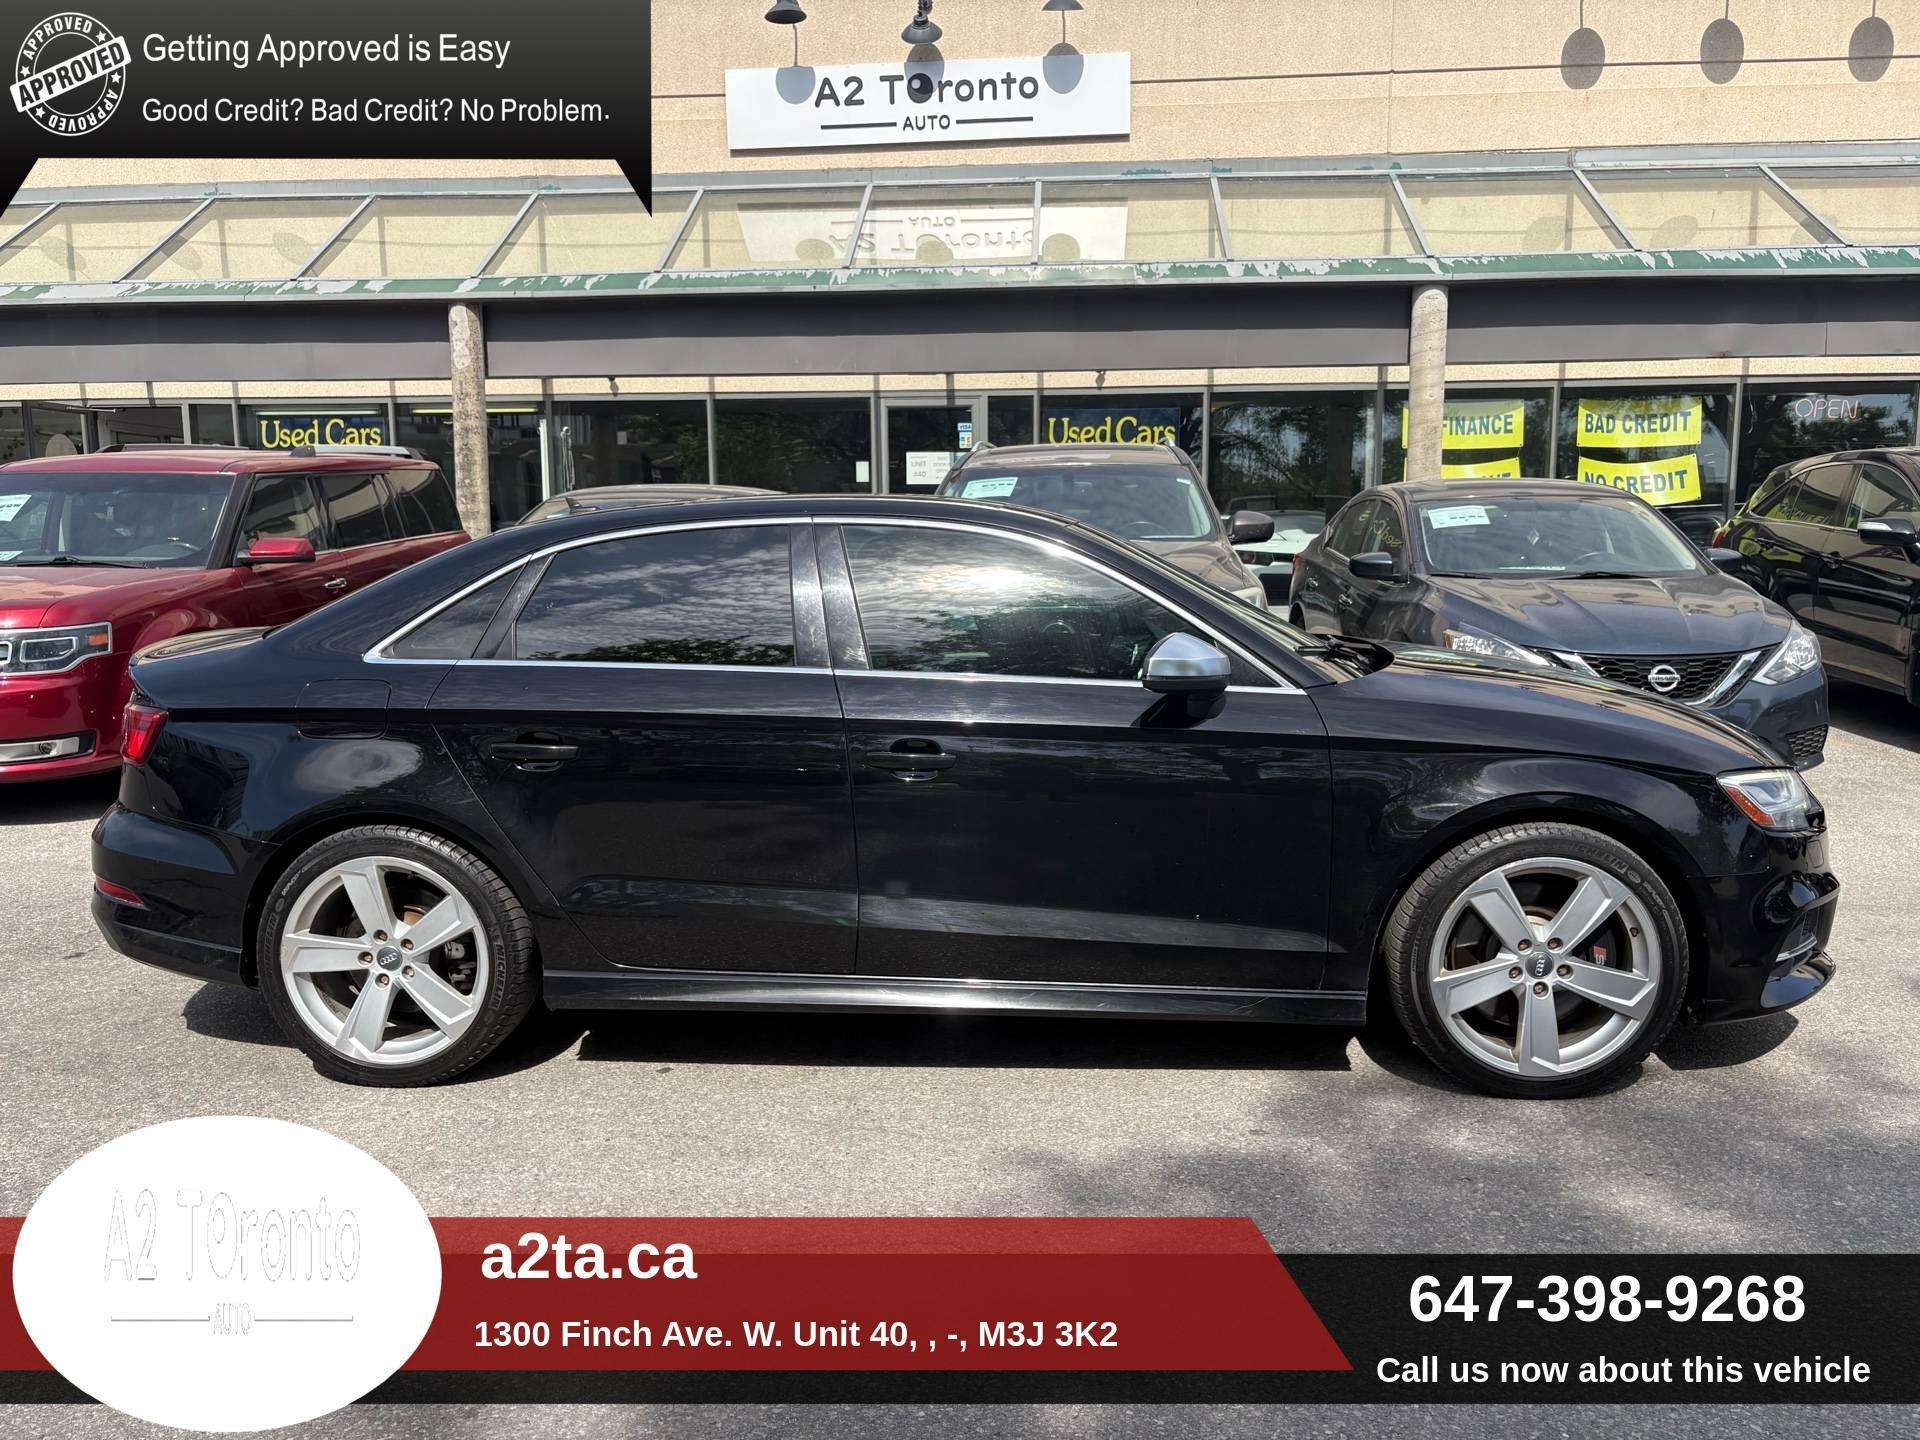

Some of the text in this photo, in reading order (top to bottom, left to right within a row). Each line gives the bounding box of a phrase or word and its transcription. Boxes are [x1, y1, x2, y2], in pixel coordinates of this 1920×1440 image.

[815, 76, 865, 108] A2
[902, 114, 951, 132] AUTO
[1795, 399, 1858, 420] OPEN
[260, 418, 381, 448] Used Cars
[1047, 415, 1175, 447] Used Cars
[1584, 411, 1692, 434] BAD CREDIT
[1613, 469, 1688, 494] CREDIT
